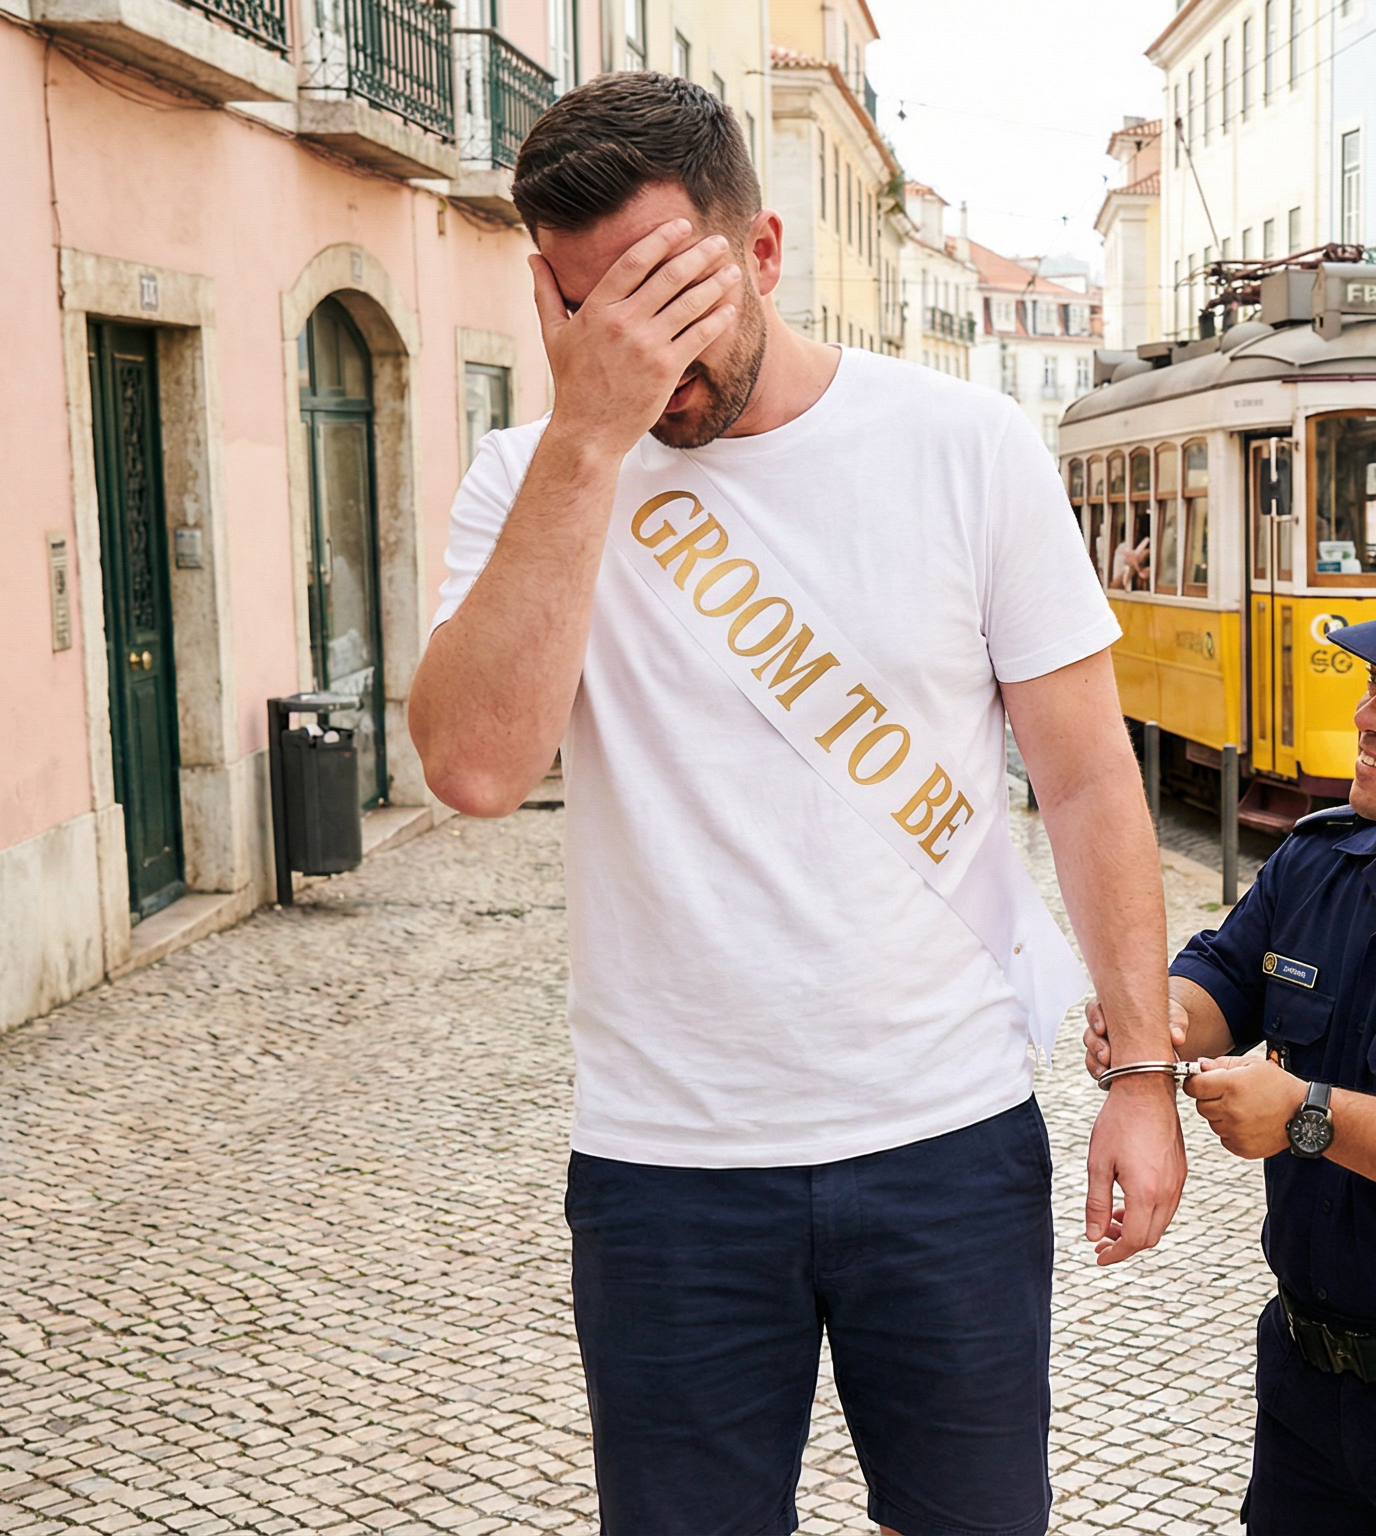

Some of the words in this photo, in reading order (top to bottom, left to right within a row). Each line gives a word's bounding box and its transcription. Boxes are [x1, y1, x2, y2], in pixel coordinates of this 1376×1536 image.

[630, 490, 841, 712] GROOM
[814, 683, 911, 786] TO
[890, 762, 975, 865] BE
